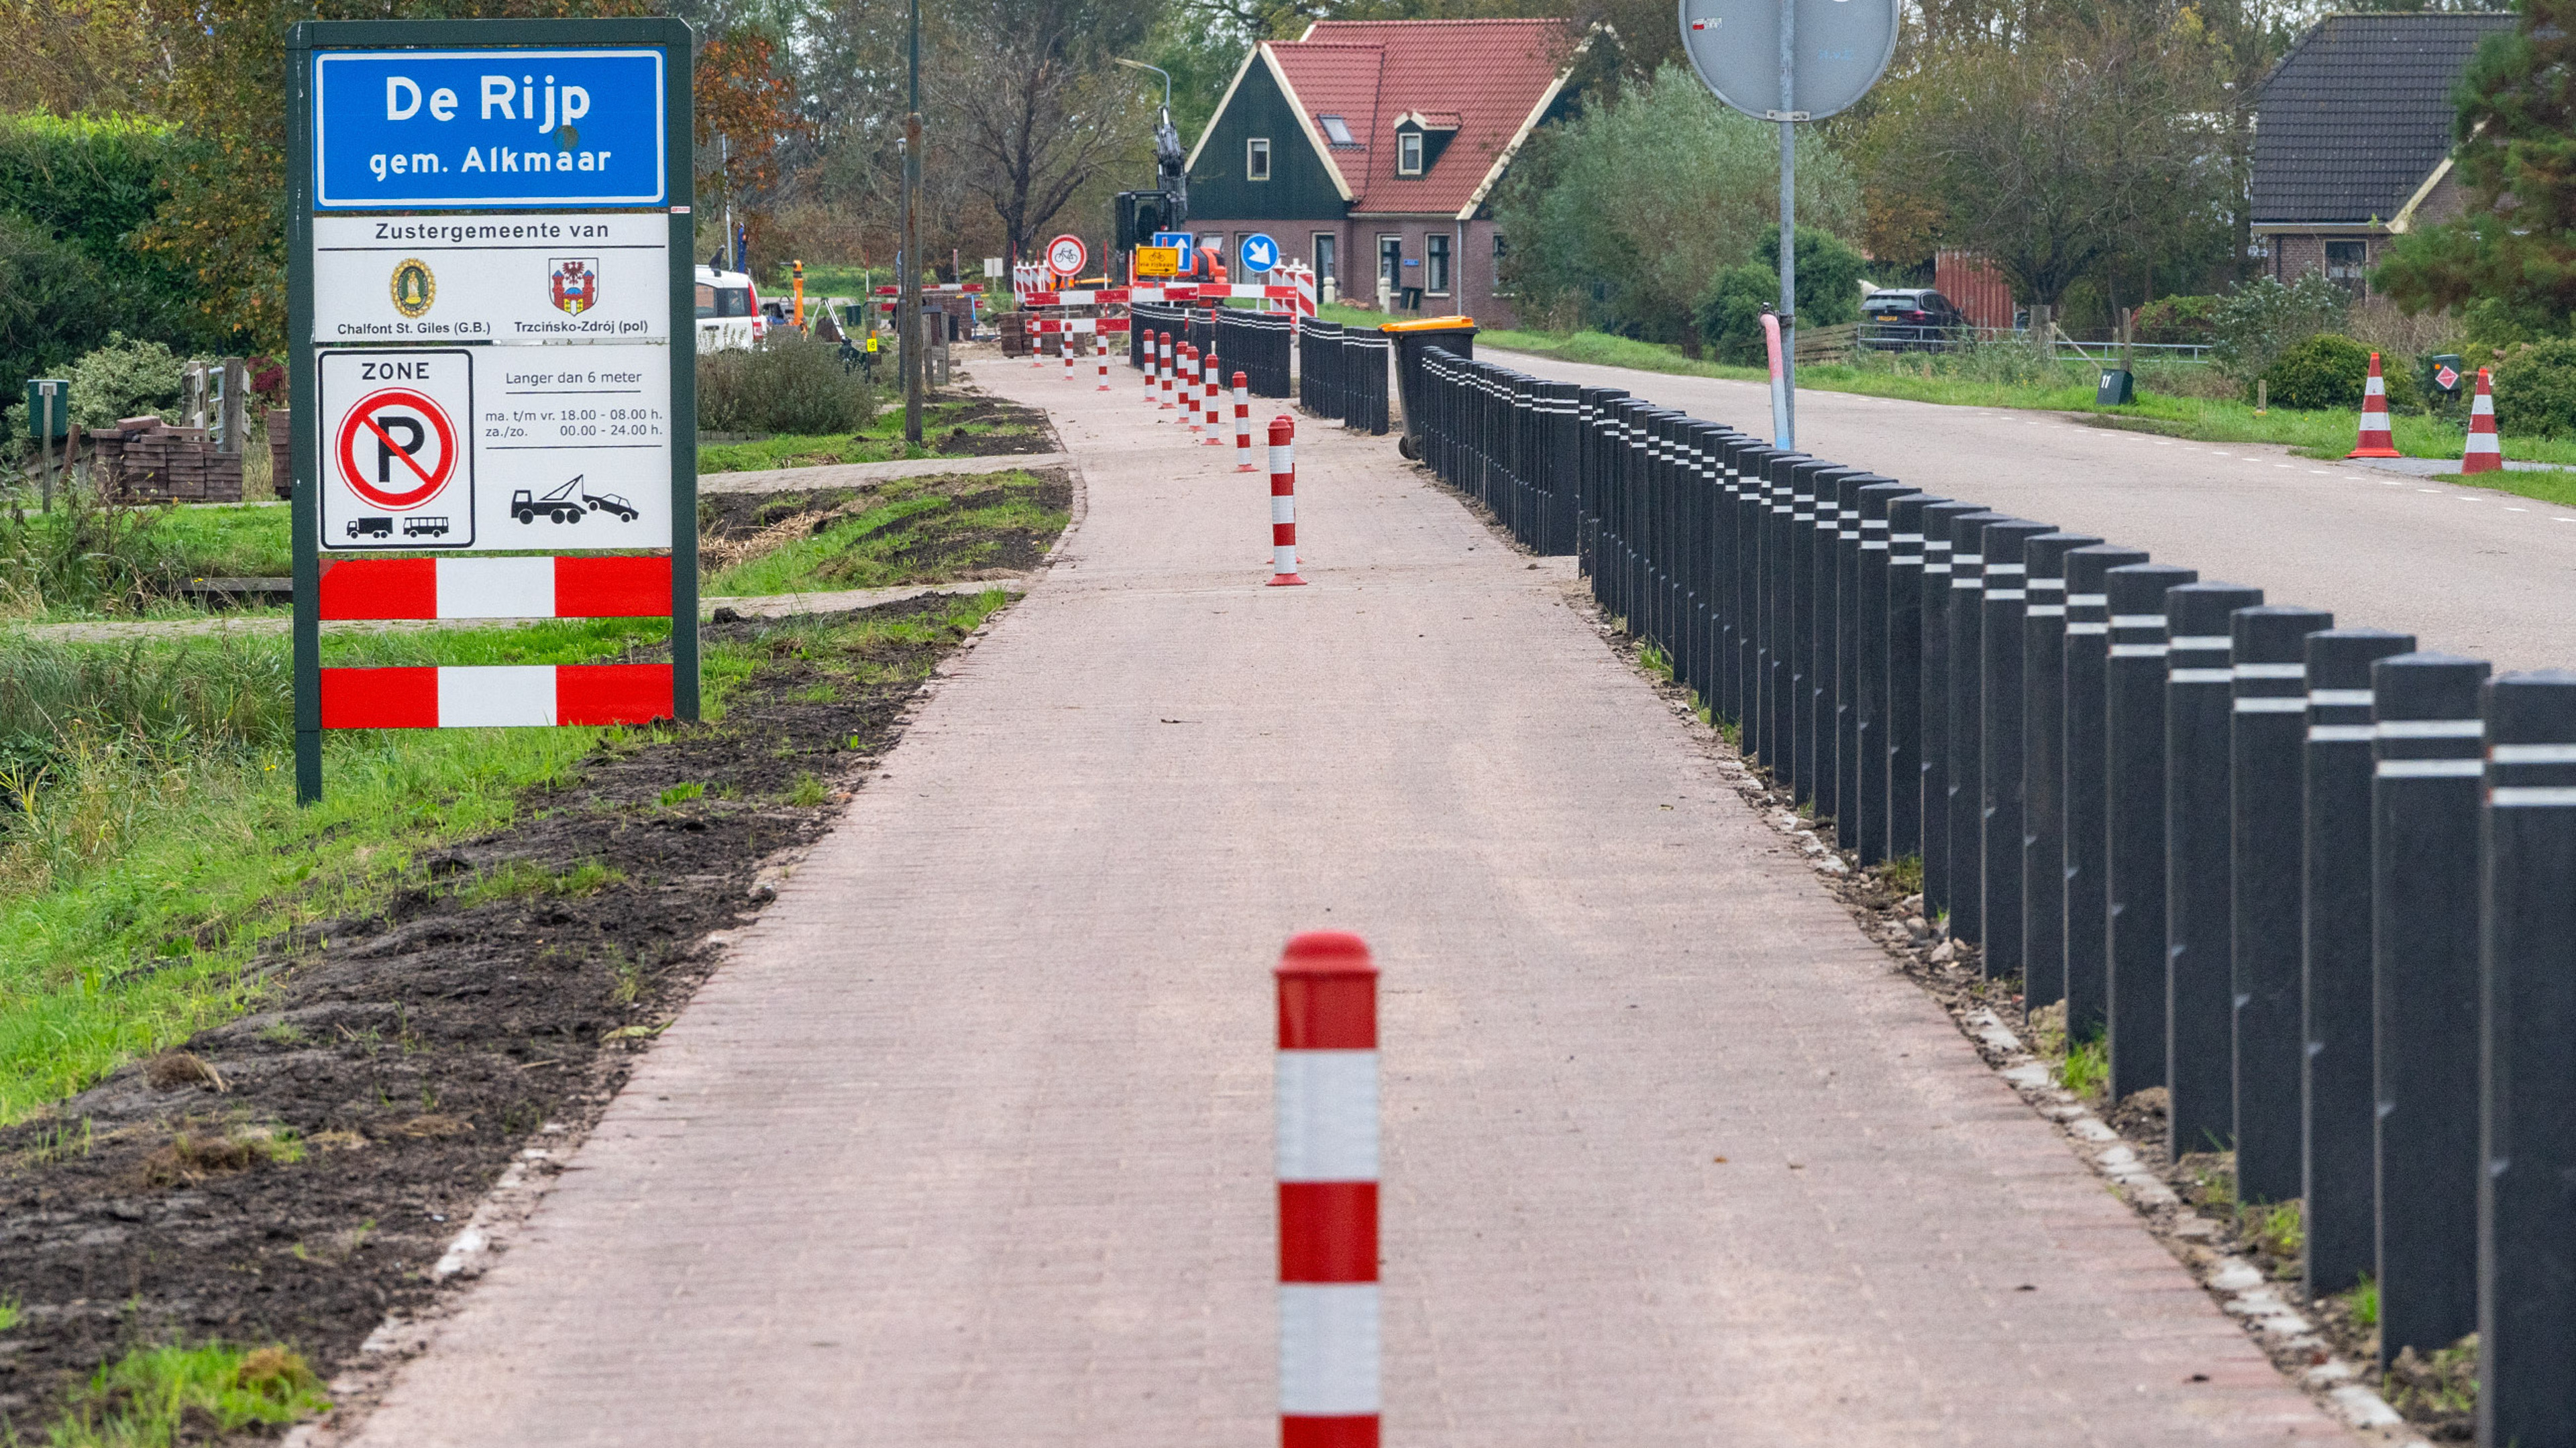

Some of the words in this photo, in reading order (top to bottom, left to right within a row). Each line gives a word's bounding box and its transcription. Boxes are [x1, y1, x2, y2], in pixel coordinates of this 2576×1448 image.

[387, 76, 458, 121] De
[481, 75, 590, 134] Rijp
[369, 153, 448, 182] gem.
[462, 146, 612, 173] Alkmaar
[375, 223, 560, 243] Zustergemeente
[569, 225, 608, 237] van
[337, 323, 392, 335] Chalfont
[396, 323, 413, 334] St.
[417, 322, 450, 334] Giles
[454, 321, 491, 336] (G.B.)
[514, 321, 614, 334] Trzcińsko-Zdrój
[619, 320, 648, 334] (pol)
[362, 362, 429, 380] ZONE
[506, 372, 554, 387] Langer
[557, 372, 583, 384] dan
[588, 371, 596, 384] 6
[601, 372, 642, 383] meter
[2101, 374, 2112, 388] 11
[486, 412, 508, 422] ma.
[513, 410, 537, 423] t/m
[540, 412, 555, 421] vr.
[561, 409, 596, 421] 18.00
[610, 408, 647, 421] 08.00
[651, 408, 663, 420] h.
[486, 426, 528, 439] za./zo.
[559, 425, 596, 436] 00.00
[610, 424, 647, 436] 24.00
[651, 424, 663, 435] h.
